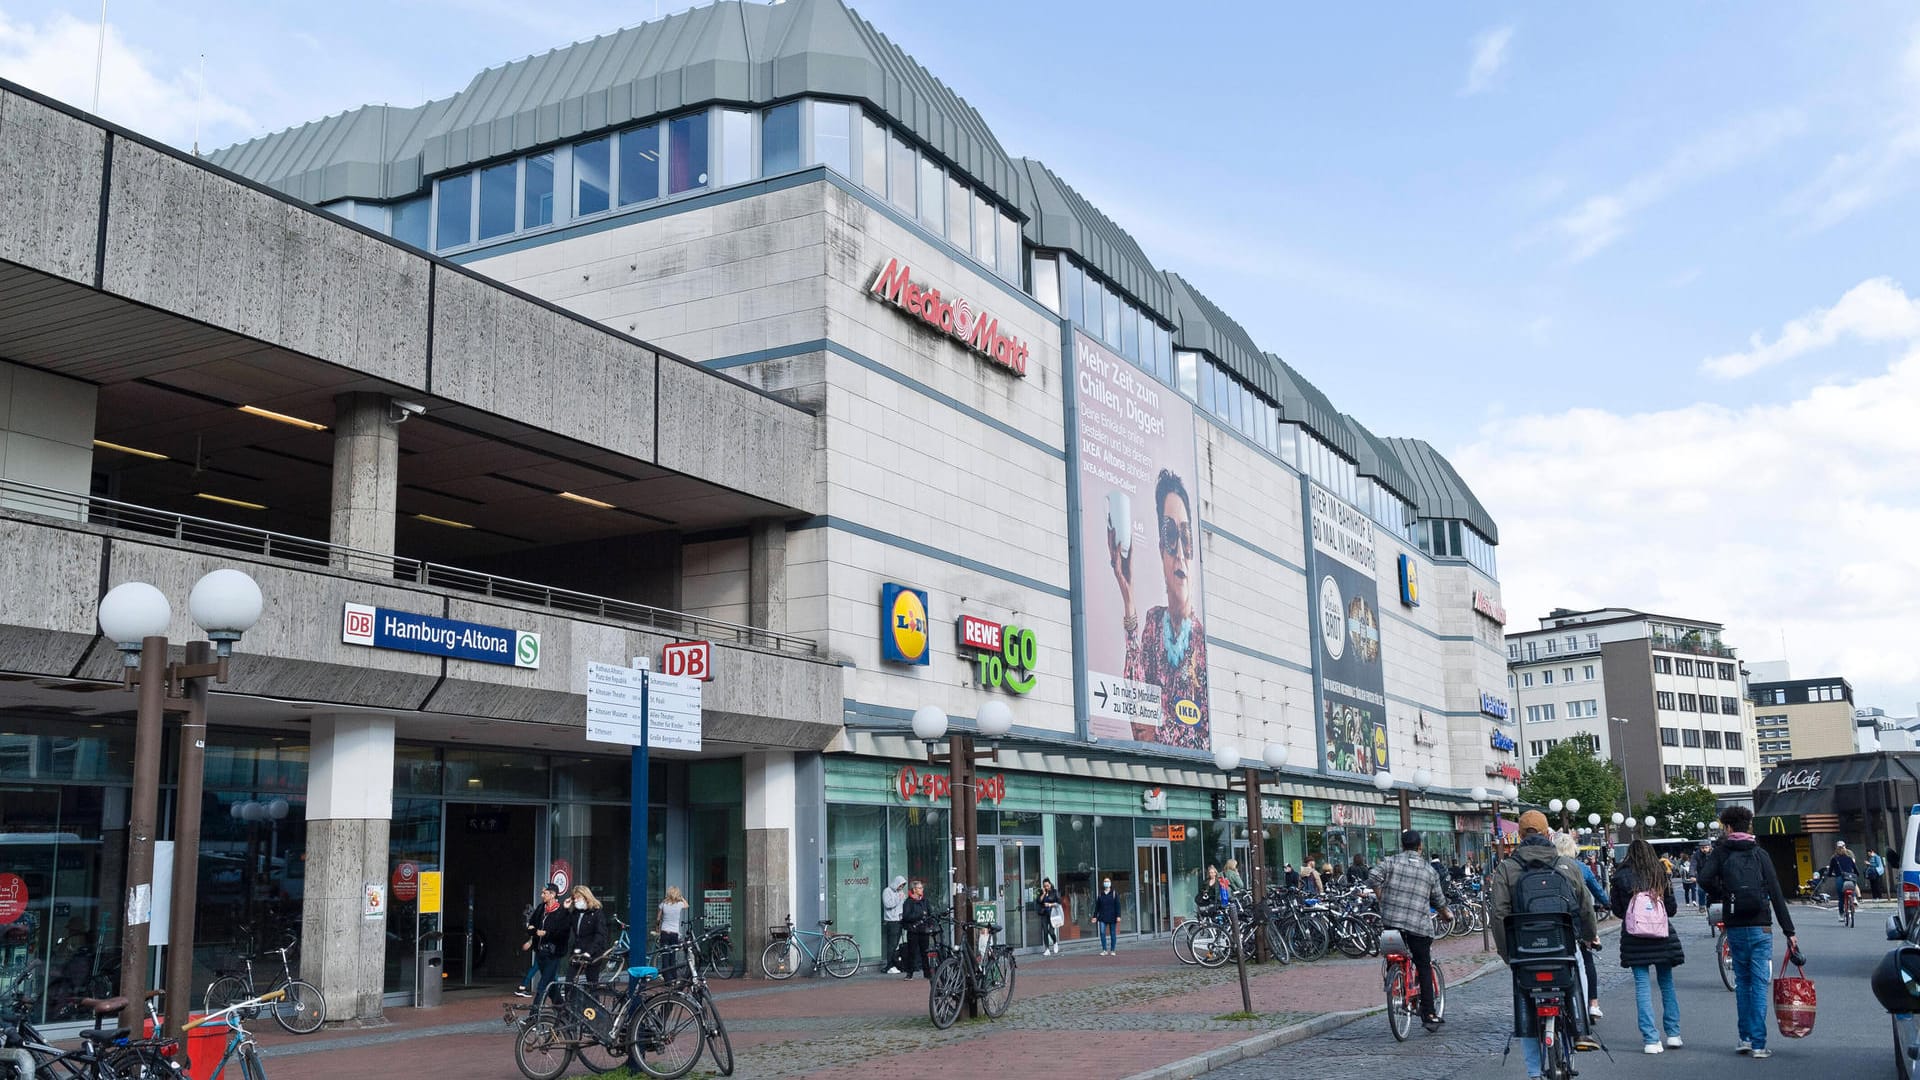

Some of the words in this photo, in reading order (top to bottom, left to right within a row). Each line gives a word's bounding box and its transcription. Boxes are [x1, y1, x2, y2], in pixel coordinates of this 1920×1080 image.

[1079, 341, 1109, 378] Mehr
[1112, 363, 1134, 394] Zeit
[1136, 383, 1159, 409] zum
[1080, 371, 1123, 417] Chillen,
[1126, 397, 1165, 438] Digger!
[1082, 439, 1101, 459] IKEA
[1103, 450, 1126, 471] Altona
[1311, 485, 1327, 516] HIER
[1328, 496, 1338, 523] IM
[1338, 503, 1365, 539] BAHNHOF
[1313, 515, 1322, 542] 60
[1323, 520, 1337, 551] MAL
[1338, 530, 1346, 556] IN
[1346, 535, 1375, 572] HAMBURG
[350, 615, 369, 633] DB
[384, 616, 508, 653] Hamburg-Altona
[965, 620, 1000, 647] REWE
[1325, 611, 1341, 642] BROT
[668, 648, 704, 676] DB
[1003, 624, 1037, 671] GO
[977, 654, 1002, 688] TO
[1113, 683, 1120, 696] In
[1121, 687, 1132, 698] nur
[1138, 689, 1160, 704] Minuten
[1113, 703, 1121, 712] zu
[1122, 702, 1137, 716] IKEA
[1179, 705, 1199, 719] IKEA
[976, 909, 996, 923] 25.09.
